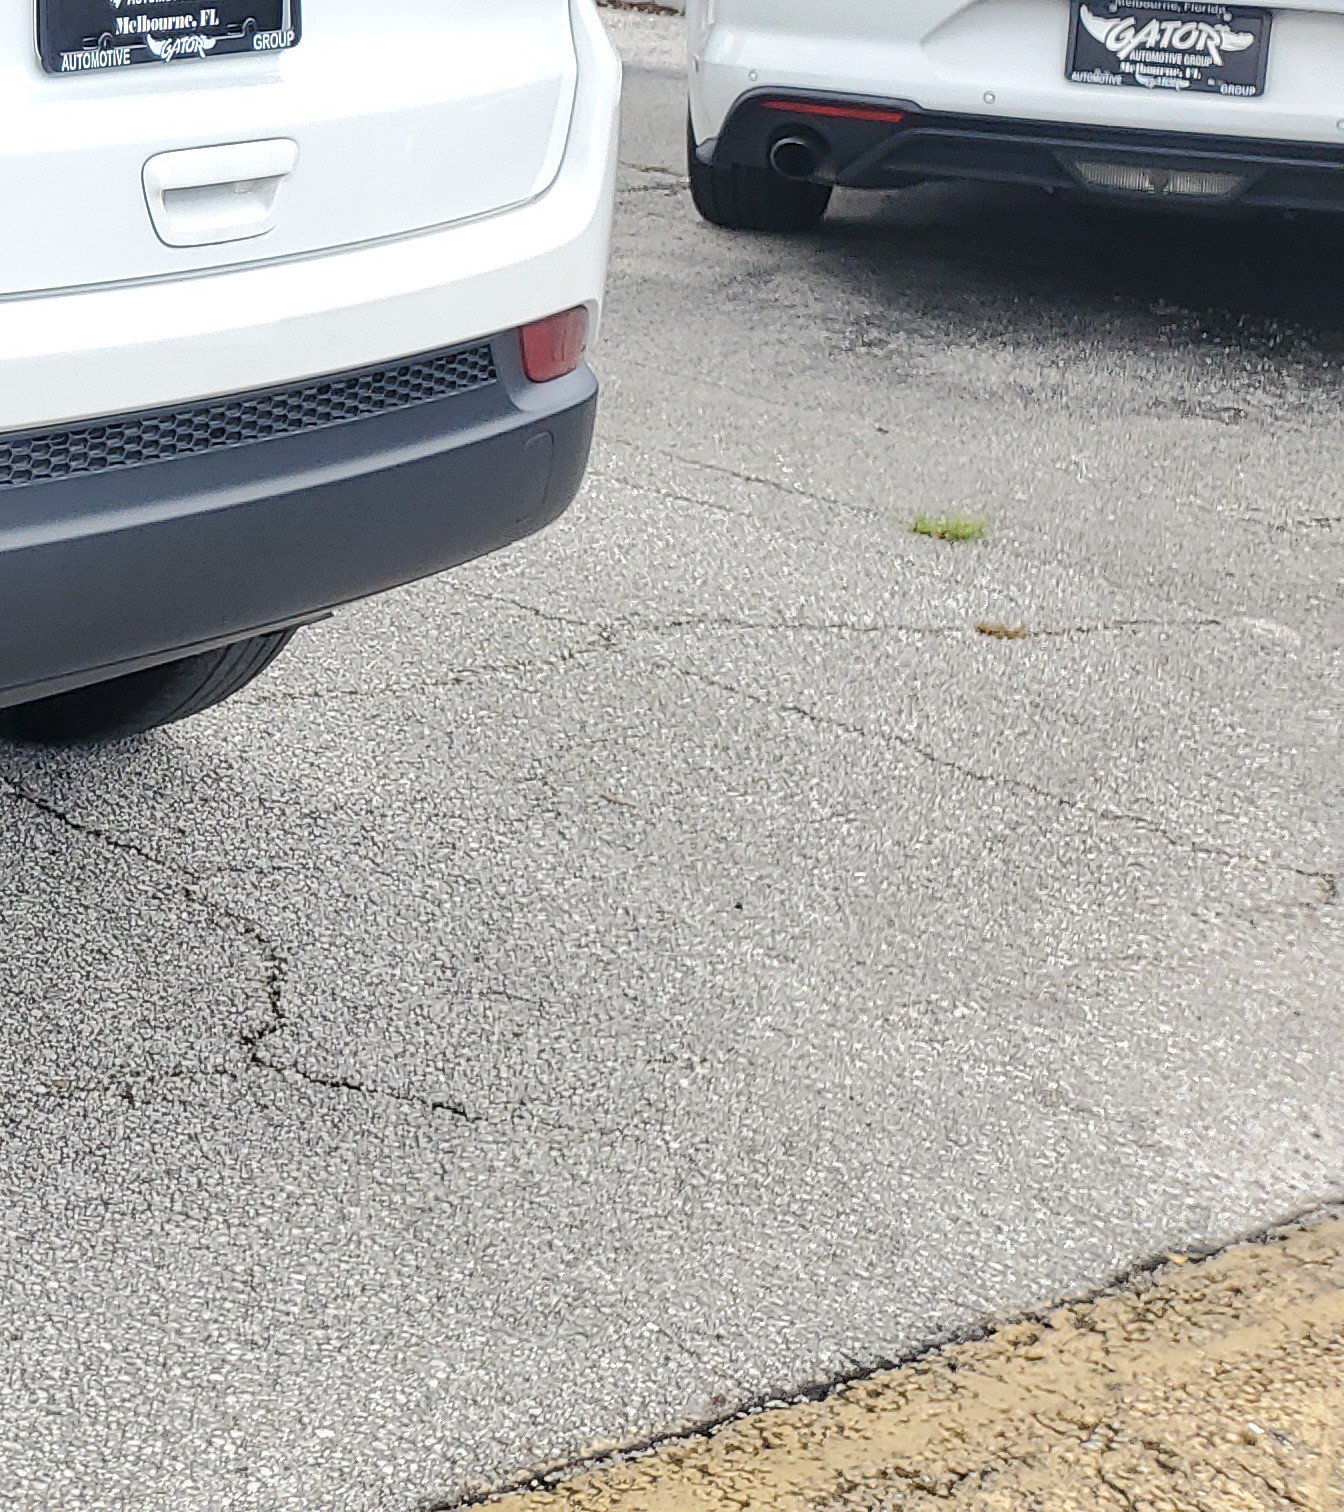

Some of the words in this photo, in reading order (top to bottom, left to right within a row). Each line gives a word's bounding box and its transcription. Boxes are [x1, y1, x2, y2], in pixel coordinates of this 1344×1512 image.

[116, 11, 197, 34] Melbourne,
[200, 9, 220, 26] FL
[62, 49, 130, 71] AUTOMOTIVE
[161, 35, 206, 62] GATOR
[253, 32, 295, 50] GROUP
[1105, 17, 1223, 66] GATOR
[1129, 50, 1182, 65] AUTOMOTIVE
[1183, 54, 1213, 67] GROUP
[1071, 72, 1123, 85] AUTOMOTIVE
[1220, 83, 1256, 96] GROUP
